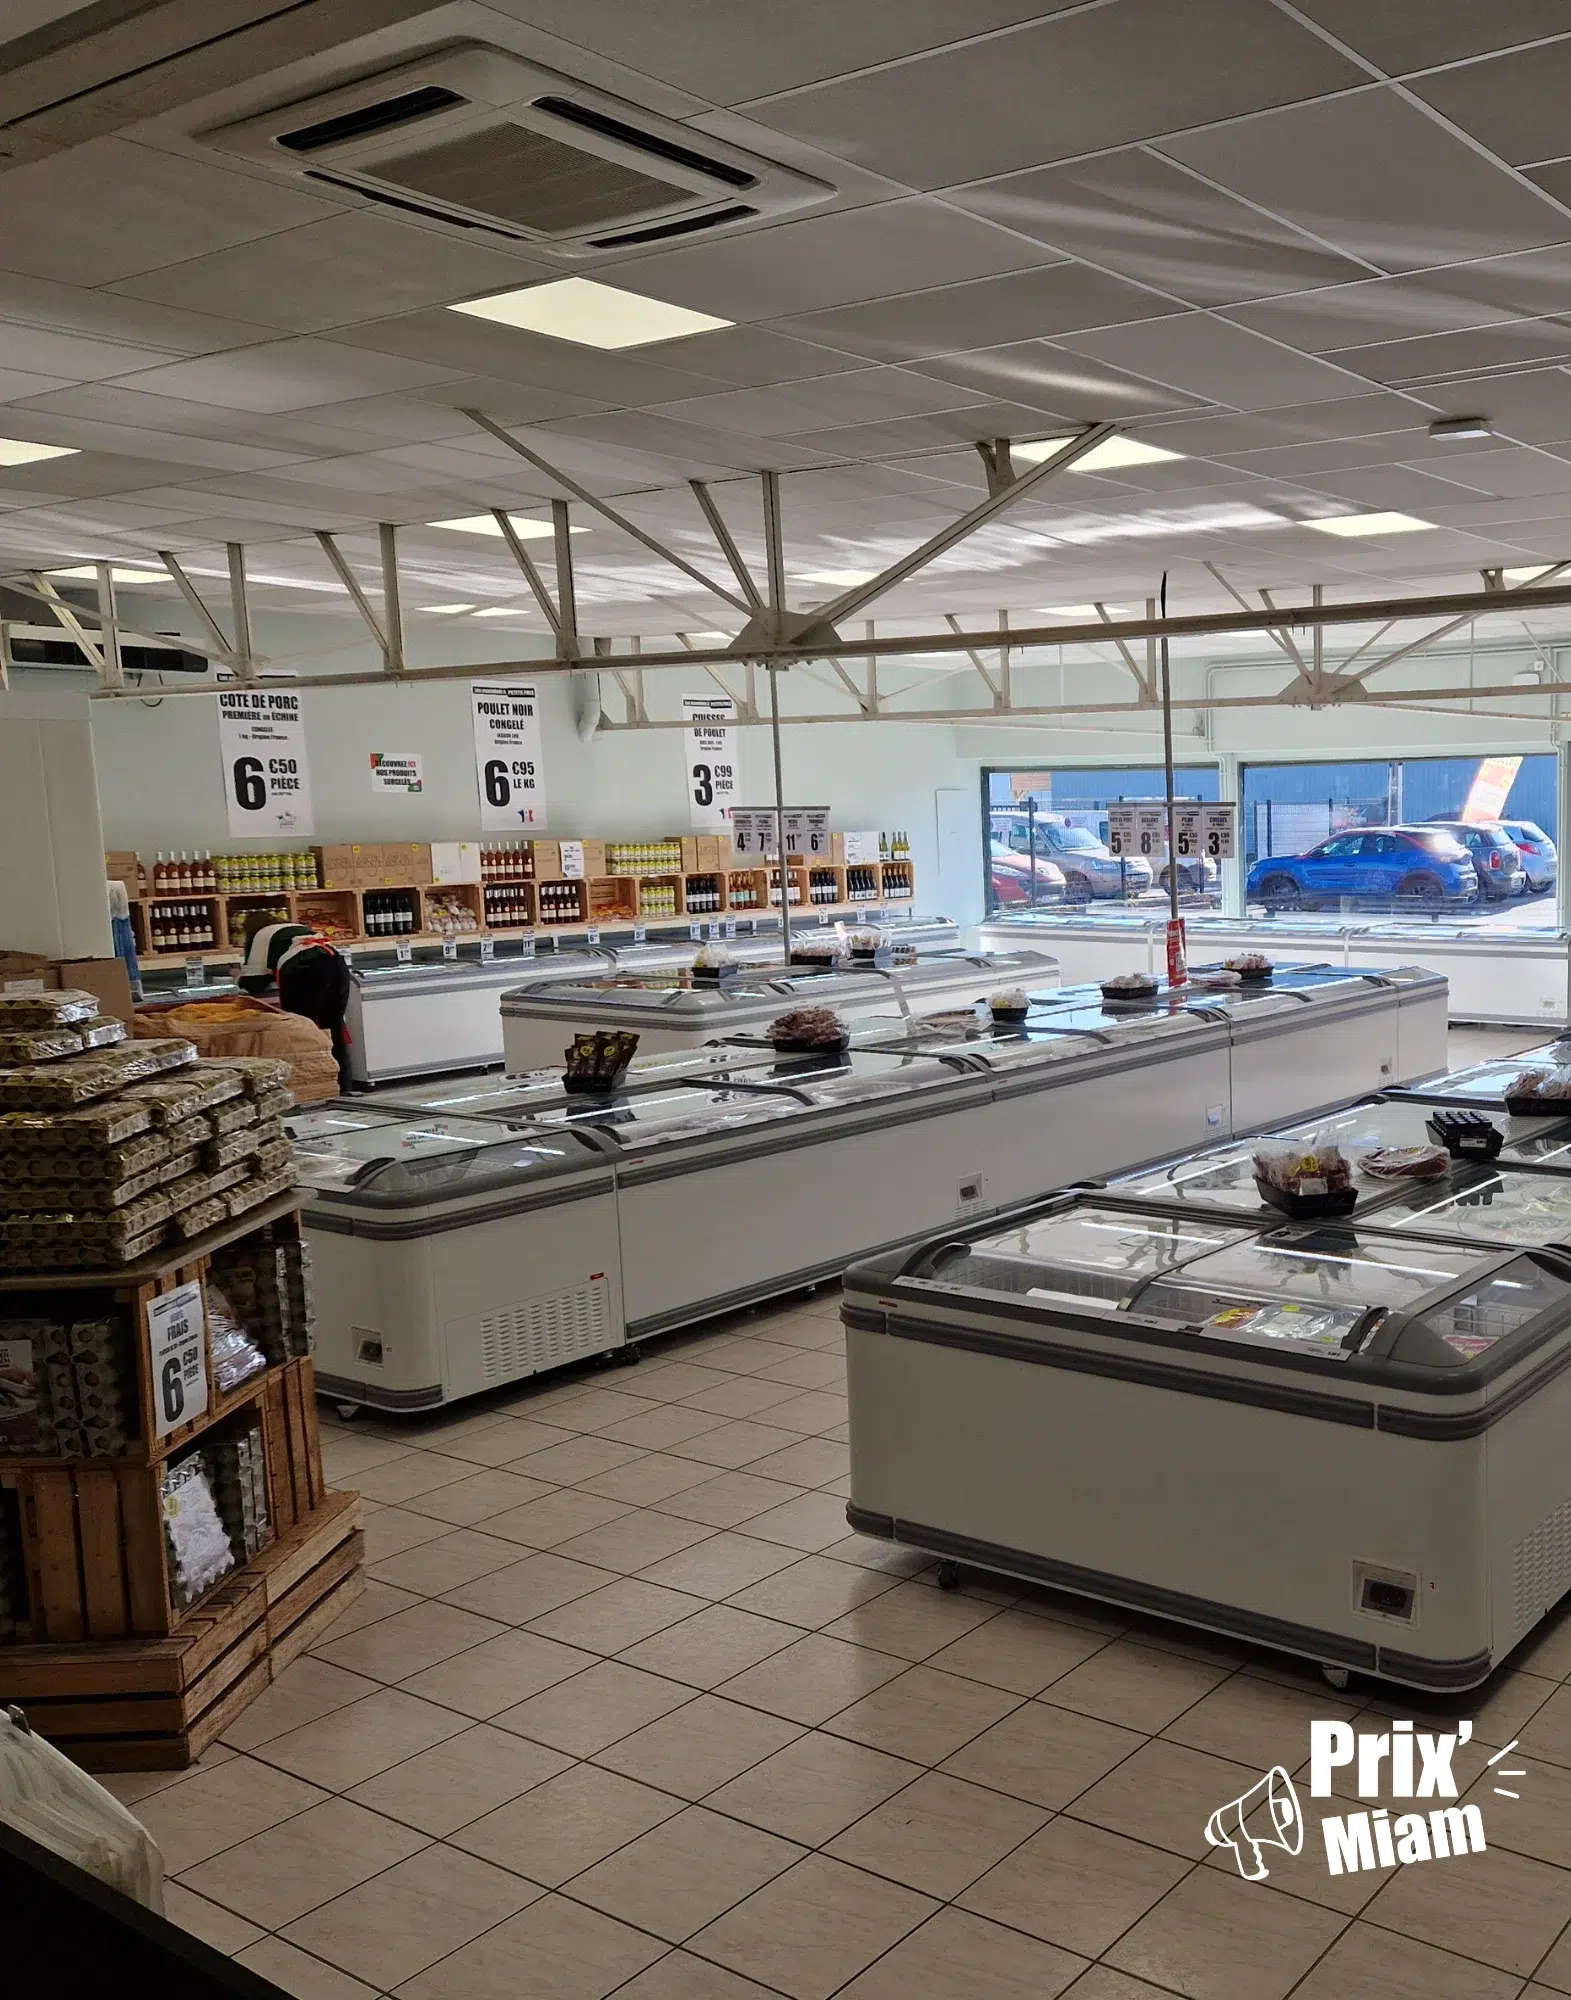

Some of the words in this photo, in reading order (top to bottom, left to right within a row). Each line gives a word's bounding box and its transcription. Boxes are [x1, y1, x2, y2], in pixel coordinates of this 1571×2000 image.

[251, 695, 266, 709] DE
[268, 696, 299, 710] PORC
[477, 702, 510, 716] POULET
[512, 704, 533, 716] NOIR
[222, 710, 261, 721] PREMIÈRE
[271, 711, 299, 722] ÉCHINE
[489, 718, 524, 730] CONGELÉ
[693, 728, 702, 737] DE
[703, 728, 726, 738] POULET
[269, 758, 297, 775] €50
[388, 769, 417, 777] PRODUITS
[512, 761, 535, 776] €95
[714, 765, 733, 778] €99
[233, 757, 267, 811] 6
[270, 775, 300, 790] PIÈCE
[484, 759, 511, 807] 6
[513, 778, 521, 789] LE
[523, 778, 535, 789] KG
[692, 764, 714, 806] 3
[715, 779, 734, 790] PIÈCE
[736, 832, 746, 851] 4
[757, 832, 765, 851] 7
[785, 833, 796, 851] 11
[810, 833, 819, 851] 6
[1111, 832, 1122, 854] 5
[1140, 832, 1152, 855] 8
[1178, 832, 1190, 855] 5
[1208, 832, 1220, 856] 3
[167, 1319, 189, 1342] FRAIS
[182, 1346, 198, 1367] €50
[162, 1357, 185, 1423] 6
